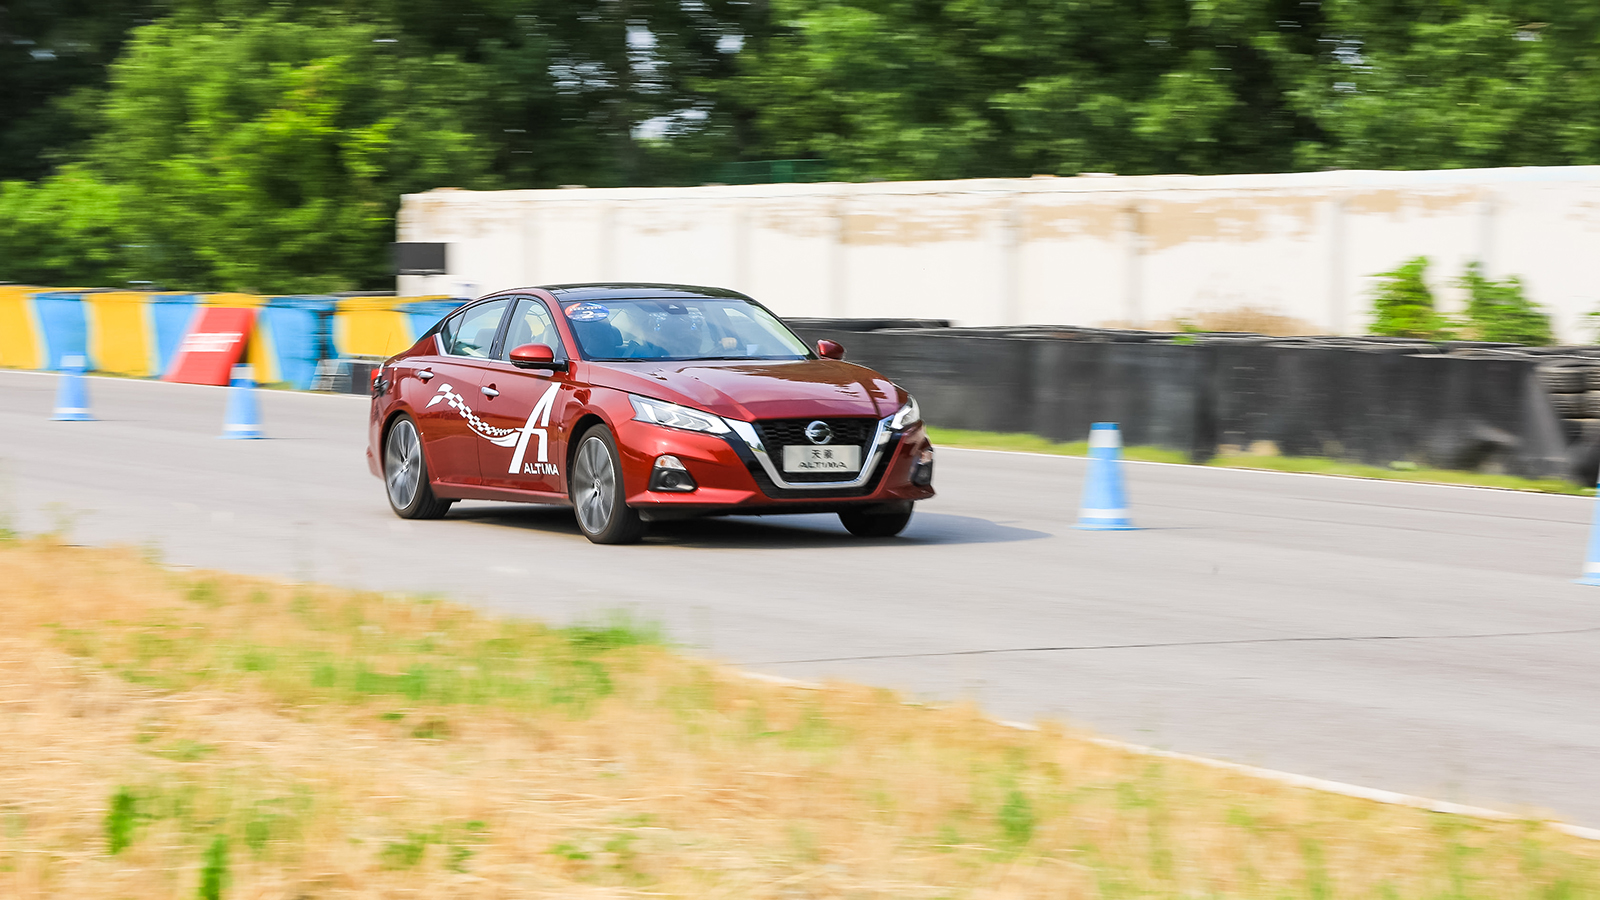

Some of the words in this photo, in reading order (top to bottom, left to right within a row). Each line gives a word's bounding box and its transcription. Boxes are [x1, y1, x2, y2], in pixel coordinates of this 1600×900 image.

[581, 310, 595, 319] 2
[524, 462, 560, 476] ALTIMA
[798, 461, 848, 469] ALTIMA
